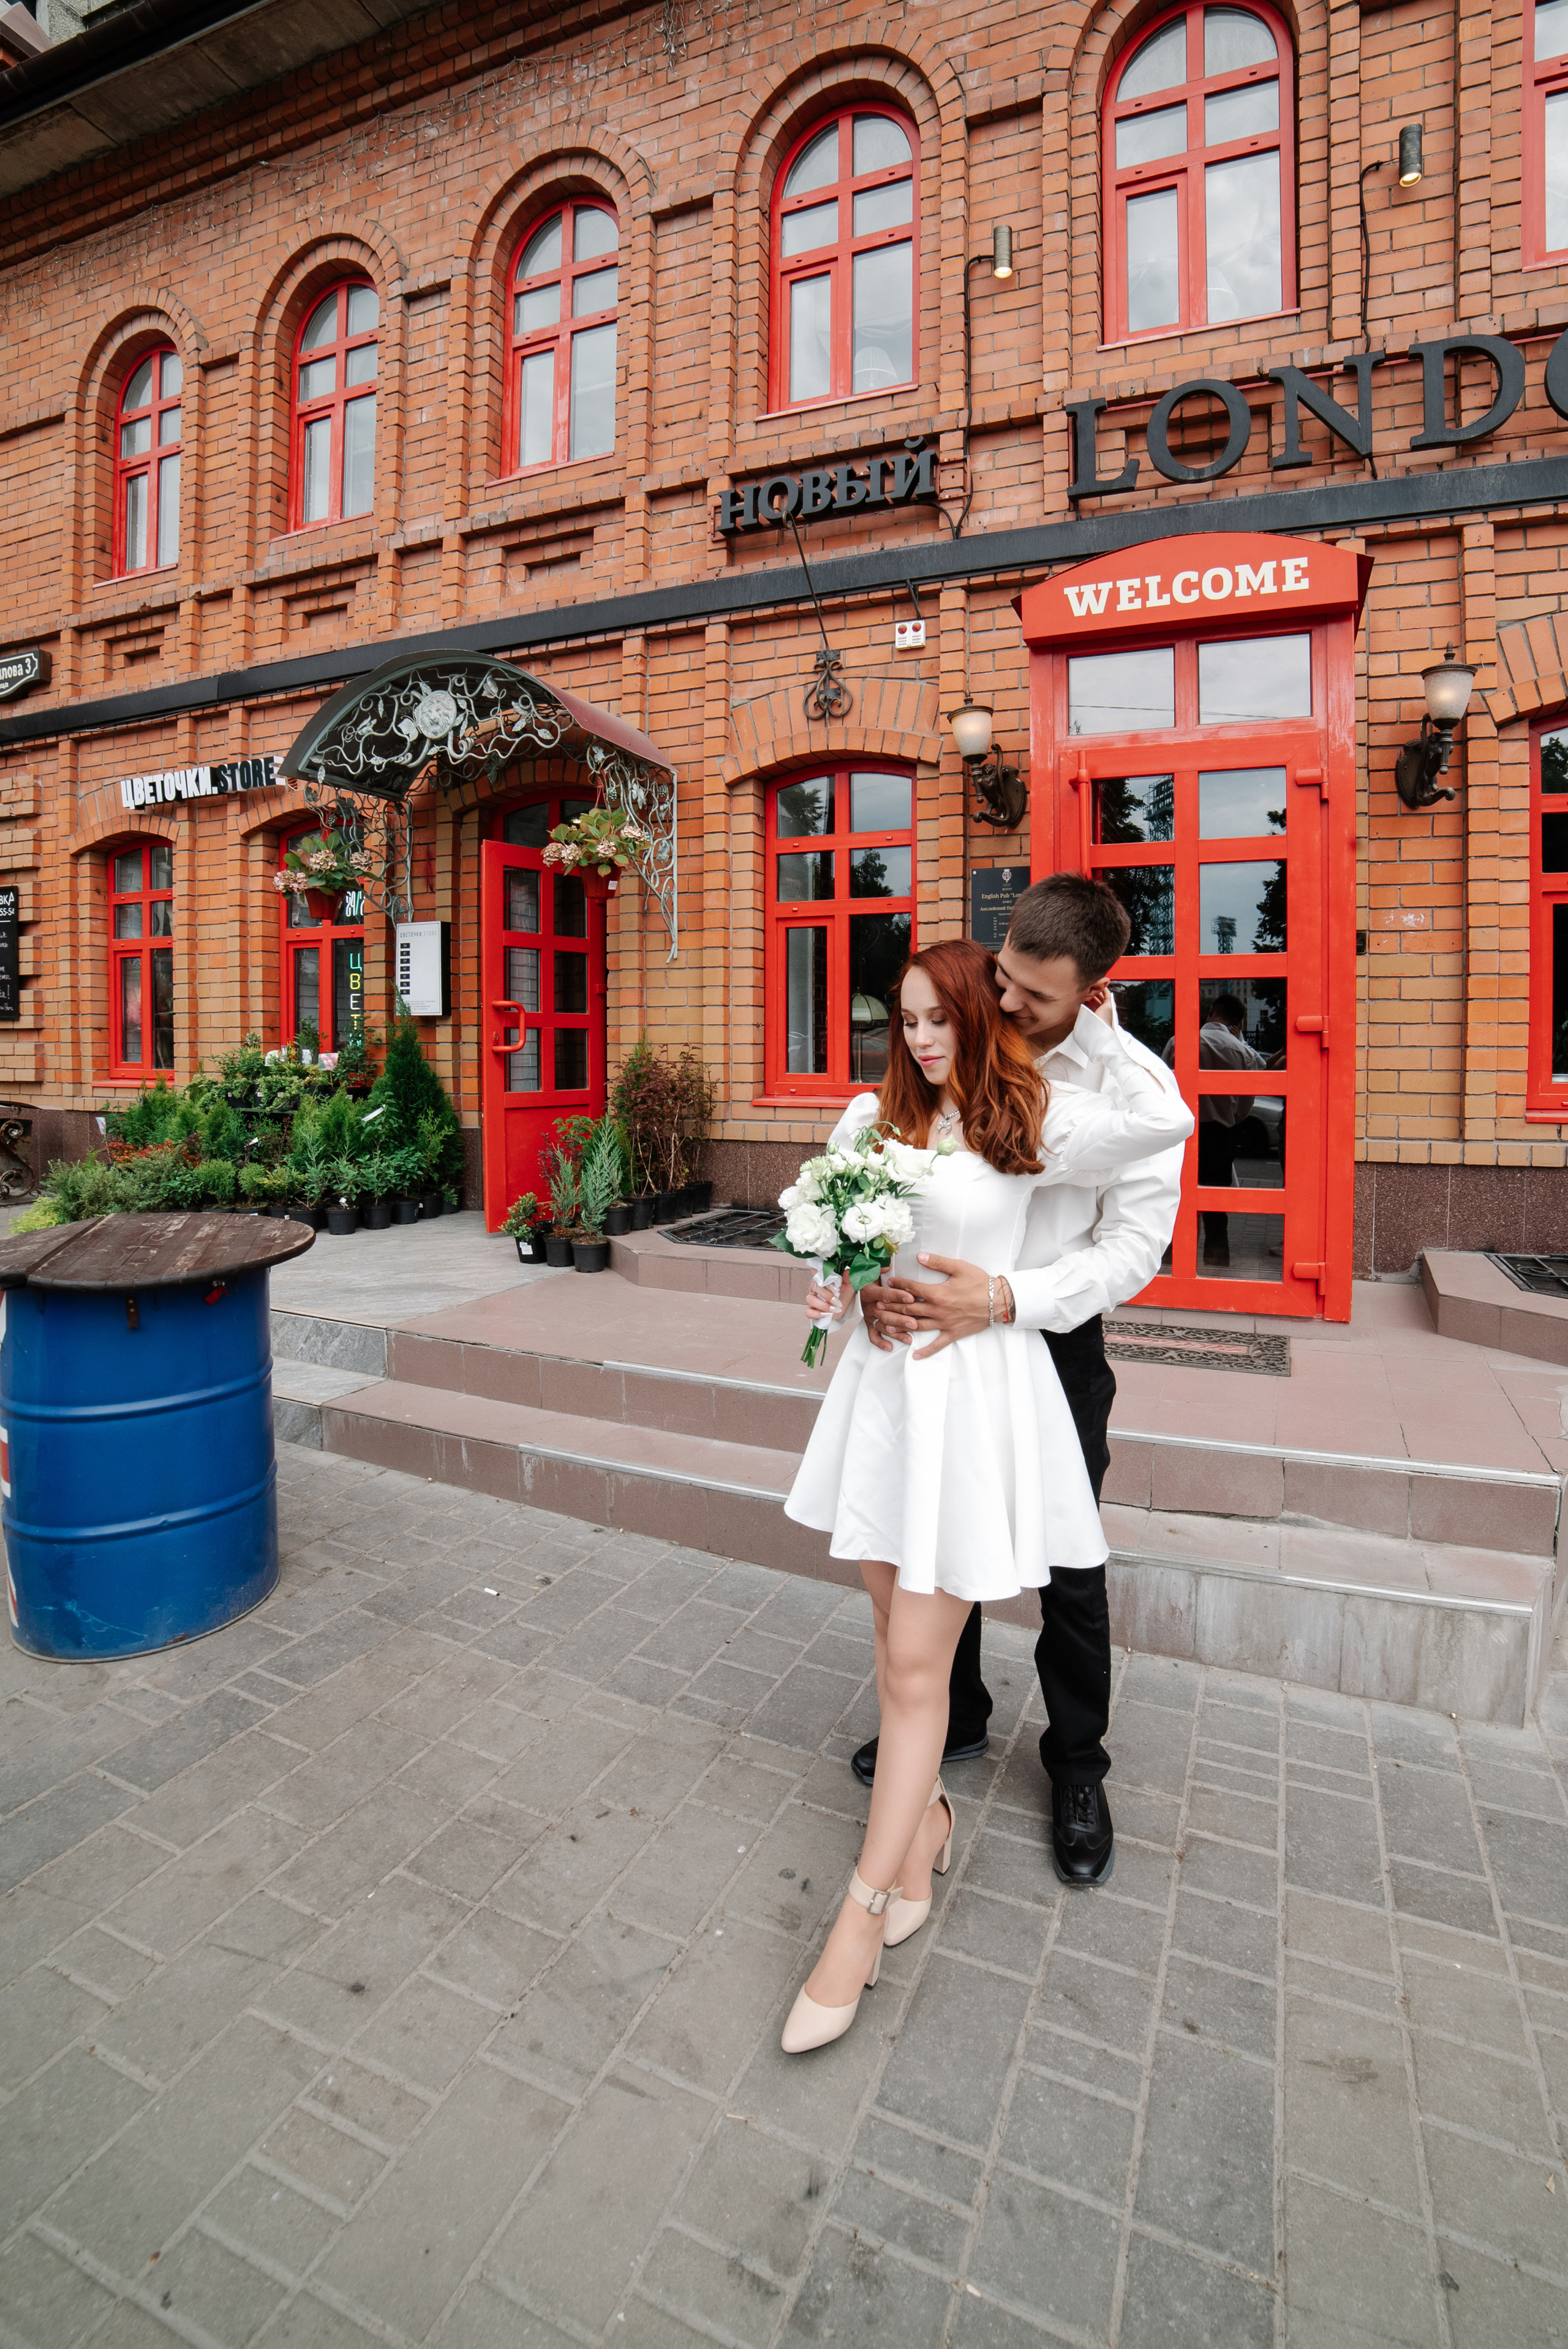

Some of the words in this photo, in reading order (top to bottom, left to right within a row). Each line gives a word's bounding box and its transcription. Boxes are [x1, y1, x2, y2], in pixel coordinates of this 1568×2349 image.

[1065, 334, 1568, 501] LOND
[716, 436, 939, 535] НОВЫЙ
[1063, 556, 1310, 617] WELCOME
[0, 664, 23, 680] лова
[25, 657, 31, 674] 3
